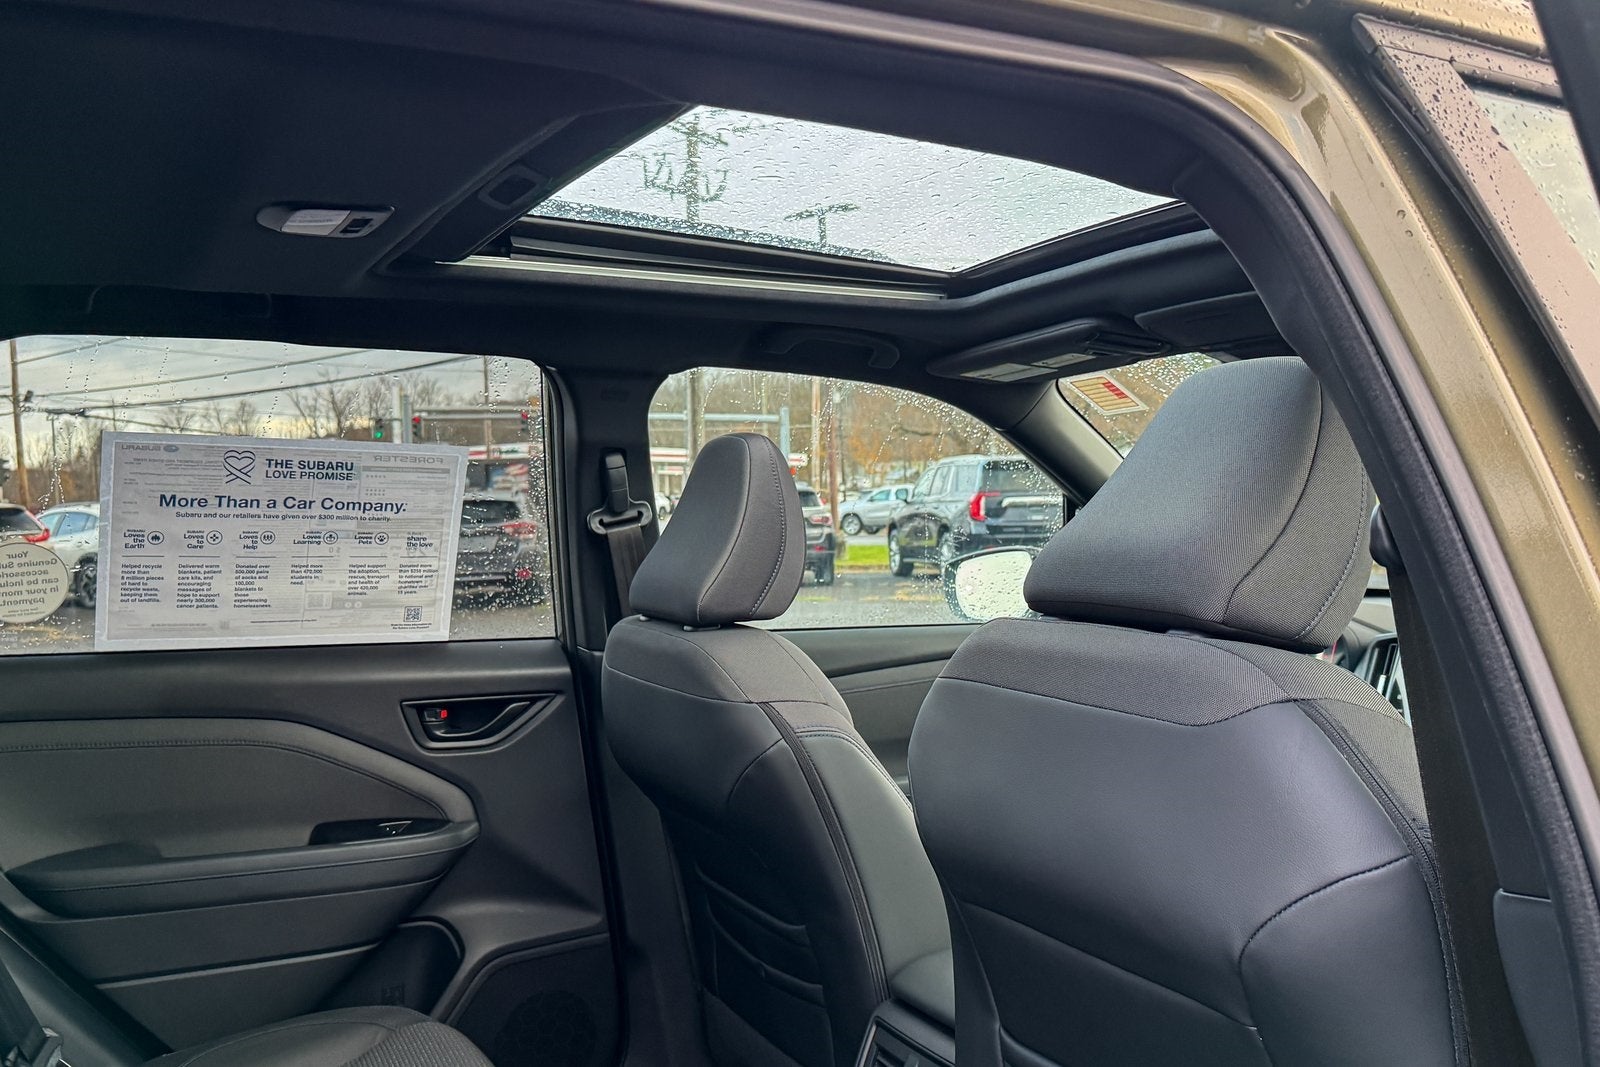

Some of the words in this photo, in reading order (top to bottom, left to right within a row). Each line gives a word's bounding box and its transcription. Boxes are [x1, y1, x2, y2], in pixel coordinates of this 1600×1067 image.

[266, 458, 293, 469] THE
[298, 460, 354, 471] SUBARU
[266, 469, 296, 479] LOVE
[300, 471, 353, 481] PROMISE
[159, 494, 208, 508] More
[214, 495, 260, 509] Than
[266, 499, 277, 509] a
[283, 496, 316, 510] Car
[321, 498, 407, 514] Company.
[282, 513, 300, 521] given
